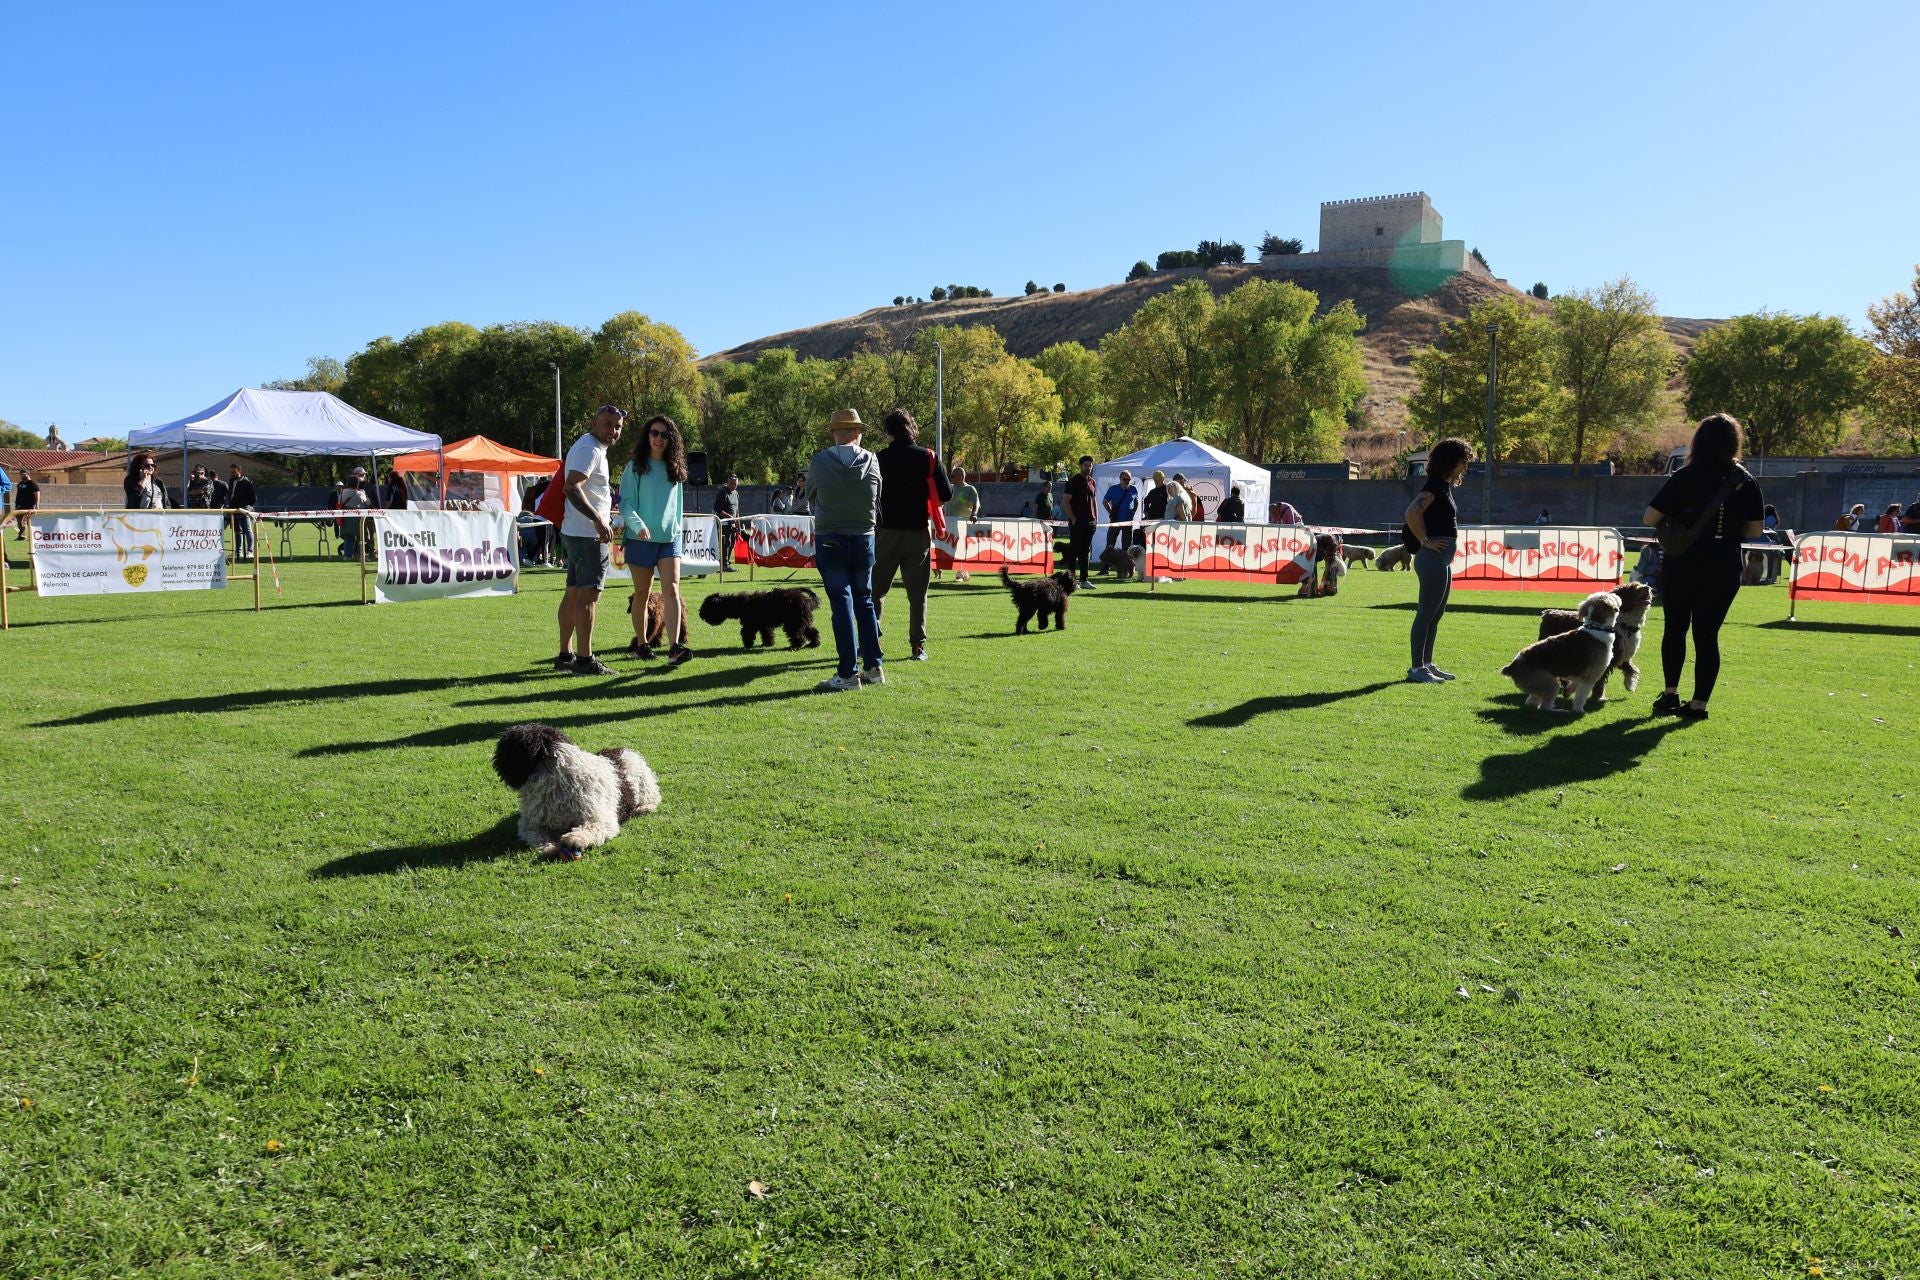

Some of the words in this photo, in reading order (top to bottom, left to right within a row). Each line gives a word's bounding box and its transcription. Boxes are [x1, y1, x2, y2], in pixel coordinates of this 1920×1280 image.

[168, 525, 223, 538] Hermanos
[384, 530, 436, 547] CrossFit
[693, 529, 703, 543] DE
[965, 530, 1015, 550] ARION
[1188, 534, 1246, 558] ARION
[1253, 537, 1315, 560] ARION
[1527, 541, 1601, 567] ARION
[384, 540, 513, 585] morado
